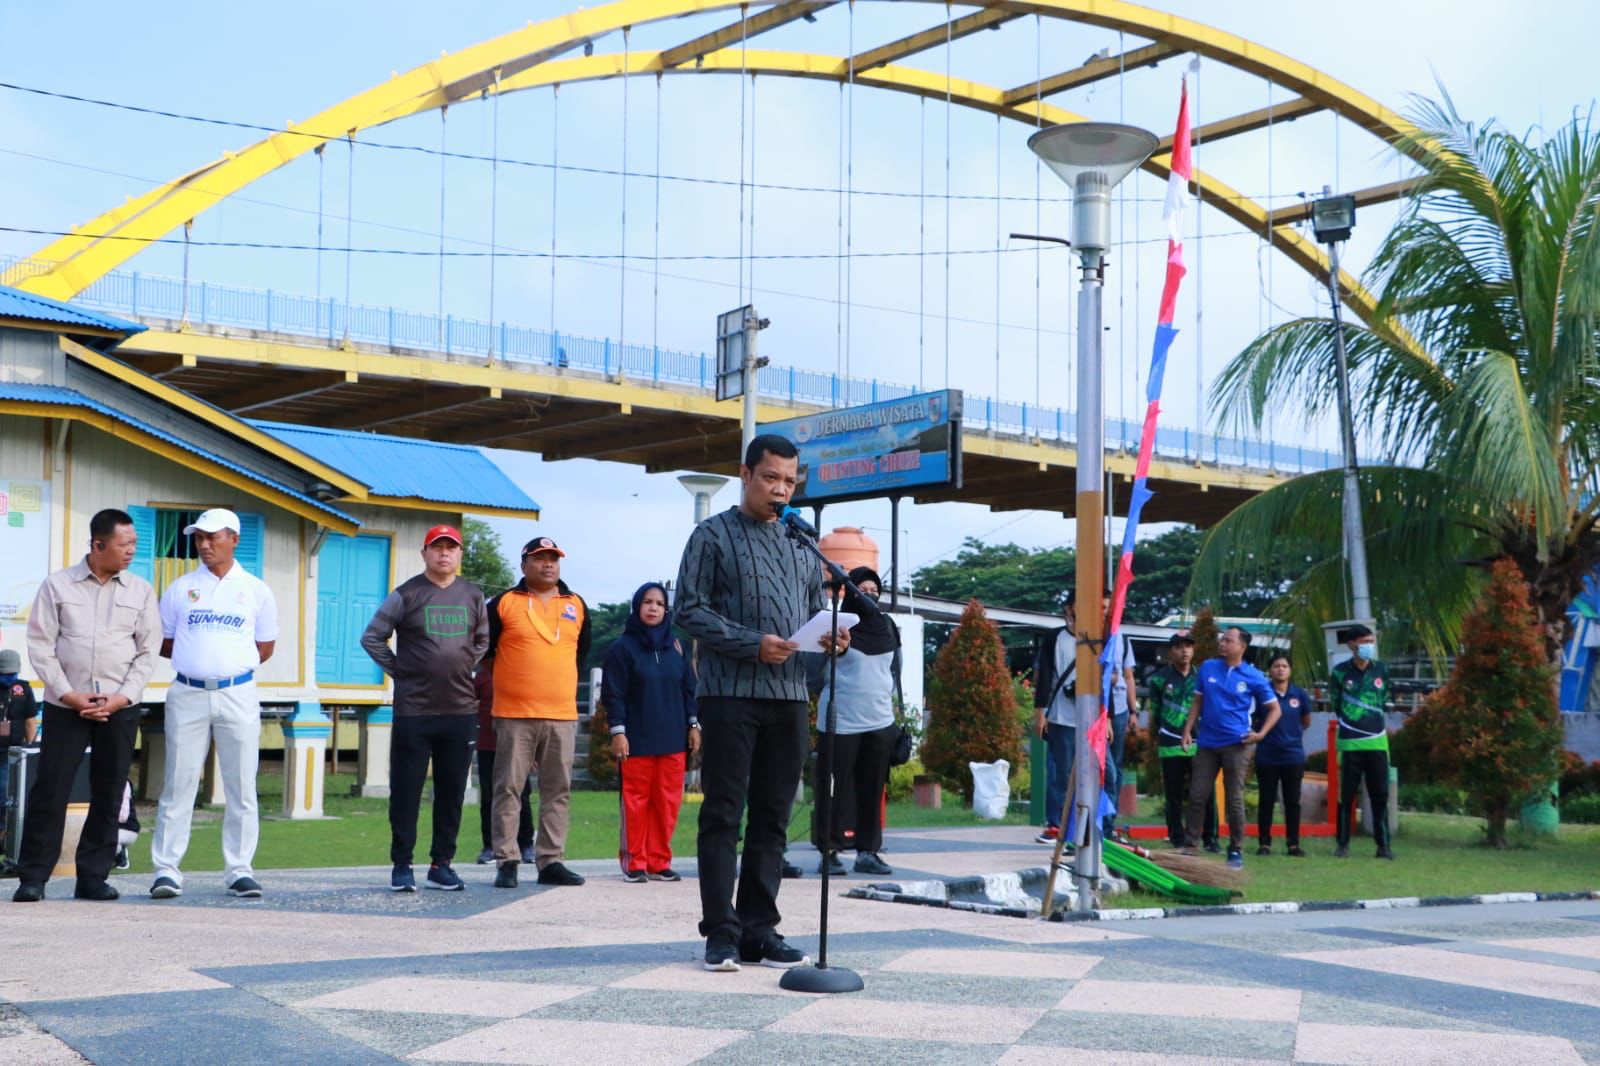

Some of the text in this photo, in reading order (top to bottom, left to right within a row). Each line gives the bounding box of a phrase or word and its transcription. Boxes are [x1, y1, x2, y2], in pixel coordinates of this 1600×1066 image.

[815, 400, 925, 437] DERMAGA WISATA
[188, 613, 246, 628] SUNMORI
